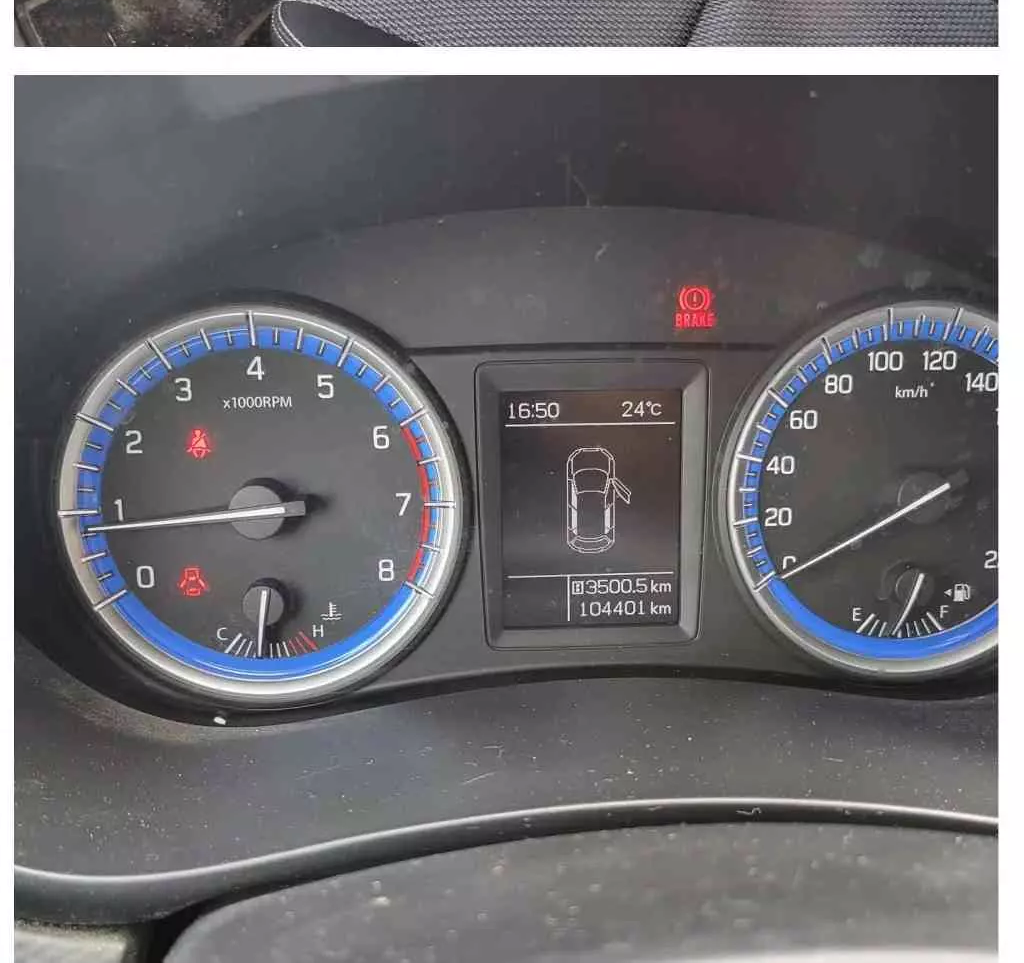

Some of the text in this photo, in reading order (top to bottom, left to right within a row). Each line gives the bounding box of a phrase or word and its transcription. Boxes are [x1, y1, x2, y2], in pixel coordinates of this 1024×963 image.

[675, 312, 715, 327] BRAKE
[246, 356, 265, 380] 4
[868, 351, 904, 371] 100
[923, 350, 957, 371] 120
[174, 378, 192, 402] 3
[317, 375, 334, 398] 5
[825, 374, 853, 394] 80
[895, 385, 929, 399] km/h
[965, 372, 998, 392] 140
[223, 396, 293, 411] x1000RPM
[508, 402, 560, 419] 16:50
[790, 410, 818, 430] 60
[126, 430, 143, 454] 2
[372, 426, 390, 449] 6
[766, 455, 795, 475] 40
[113, 498, 124, 521] 1
[395, 493, 411, 516] 7
[765, 507, 793, 527] 20
[136, 565, 155, 588] 0
[378, 559, 395, 581] 8
[650, 579, 672, 593] km
[580, 600, 672, 617] 104401 km
[852, 608, 862, 622] E
[940, 605, 949, 619] F
[216, 627, 227, 641] C
[313, 625, 324, 637] H
